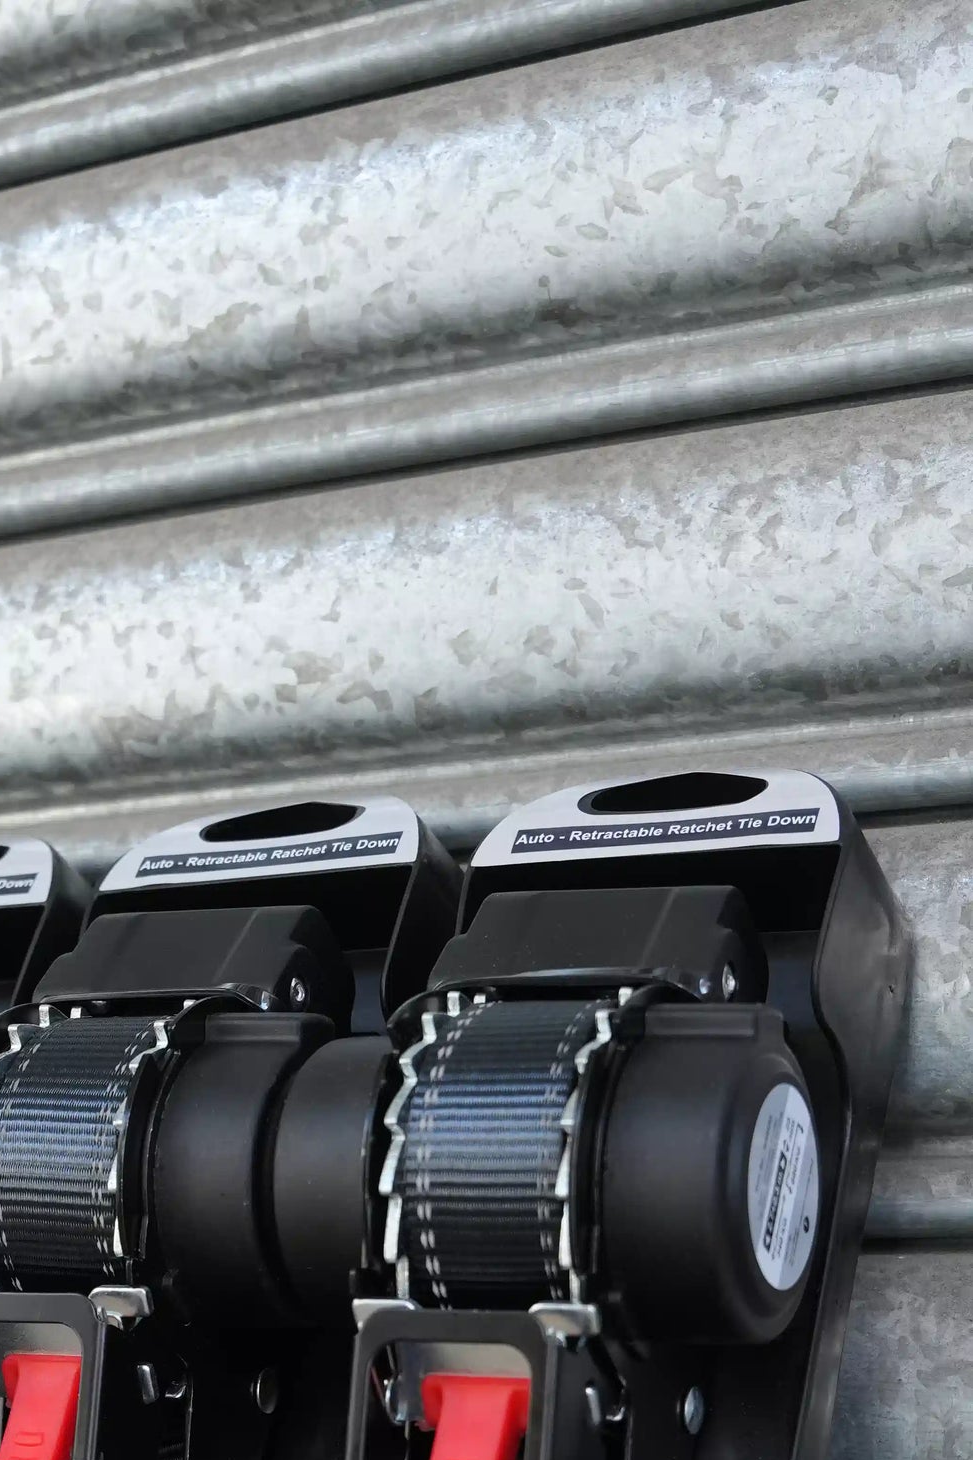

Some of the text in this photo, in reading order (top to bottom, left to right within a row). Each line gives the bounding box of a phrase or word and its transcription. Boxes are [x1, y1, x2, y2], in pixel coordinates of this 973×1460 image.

[515, 832, 555, 846] Auto
[569, 825, 663, 842] Retractable
[667, 820, 733, 836] Ratchet
[738, 818, 763, 829] Tie
[767, 814, 817, 827] Down
[139, 859, 174, 871] Auto
[186, 852, 267, 867] Retractable
[270, 844, 327, 860] Ratchet
[331, 841, 352, 852] Tie
[356, 836, 399, 849] Down
